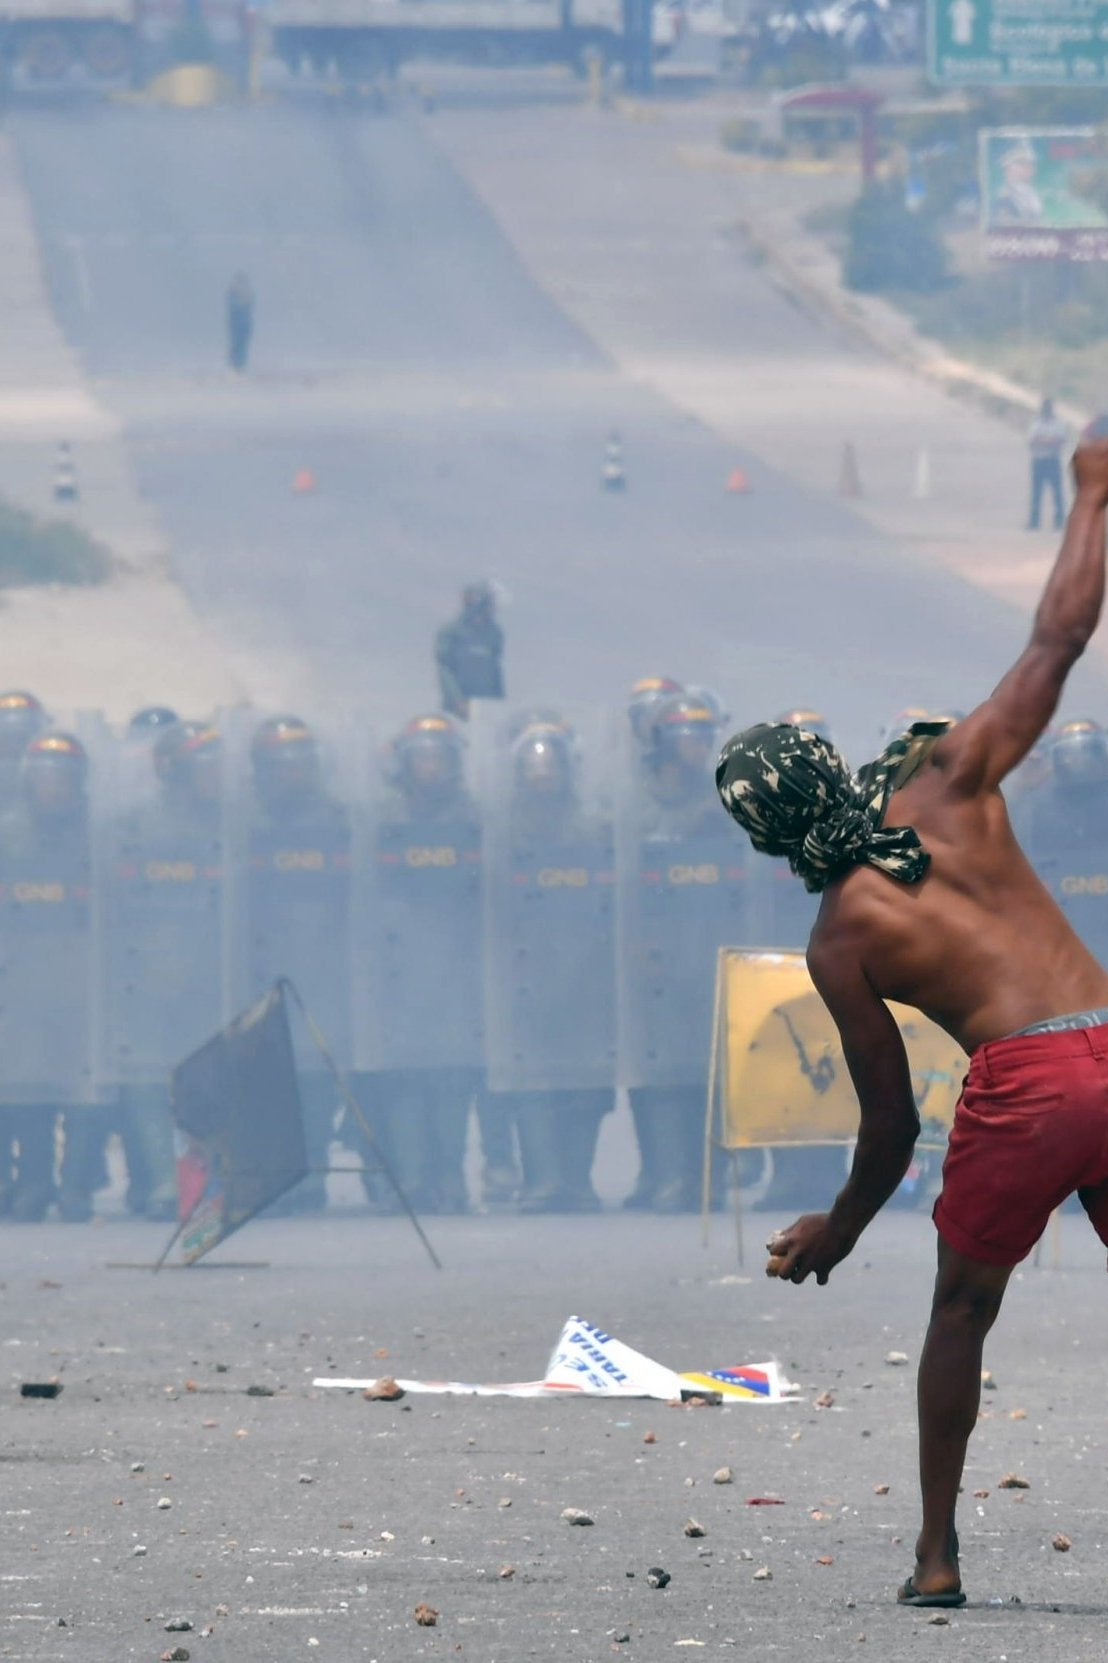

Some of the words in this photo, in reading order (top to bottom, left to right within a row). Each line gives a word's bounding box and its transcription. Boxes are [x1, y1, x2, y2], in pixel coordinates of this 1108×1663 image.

[273, 850, 326, 871] GNB
[406, 846, 456, 867] GNB
[144, 859, 196, 881] GNB
[537, 868, 589, 888] GNB
[668, 864, 720, 885] GNB
[12, 881, 65, 903] GNB
[569, 1332, 627, 1385] TARIA
